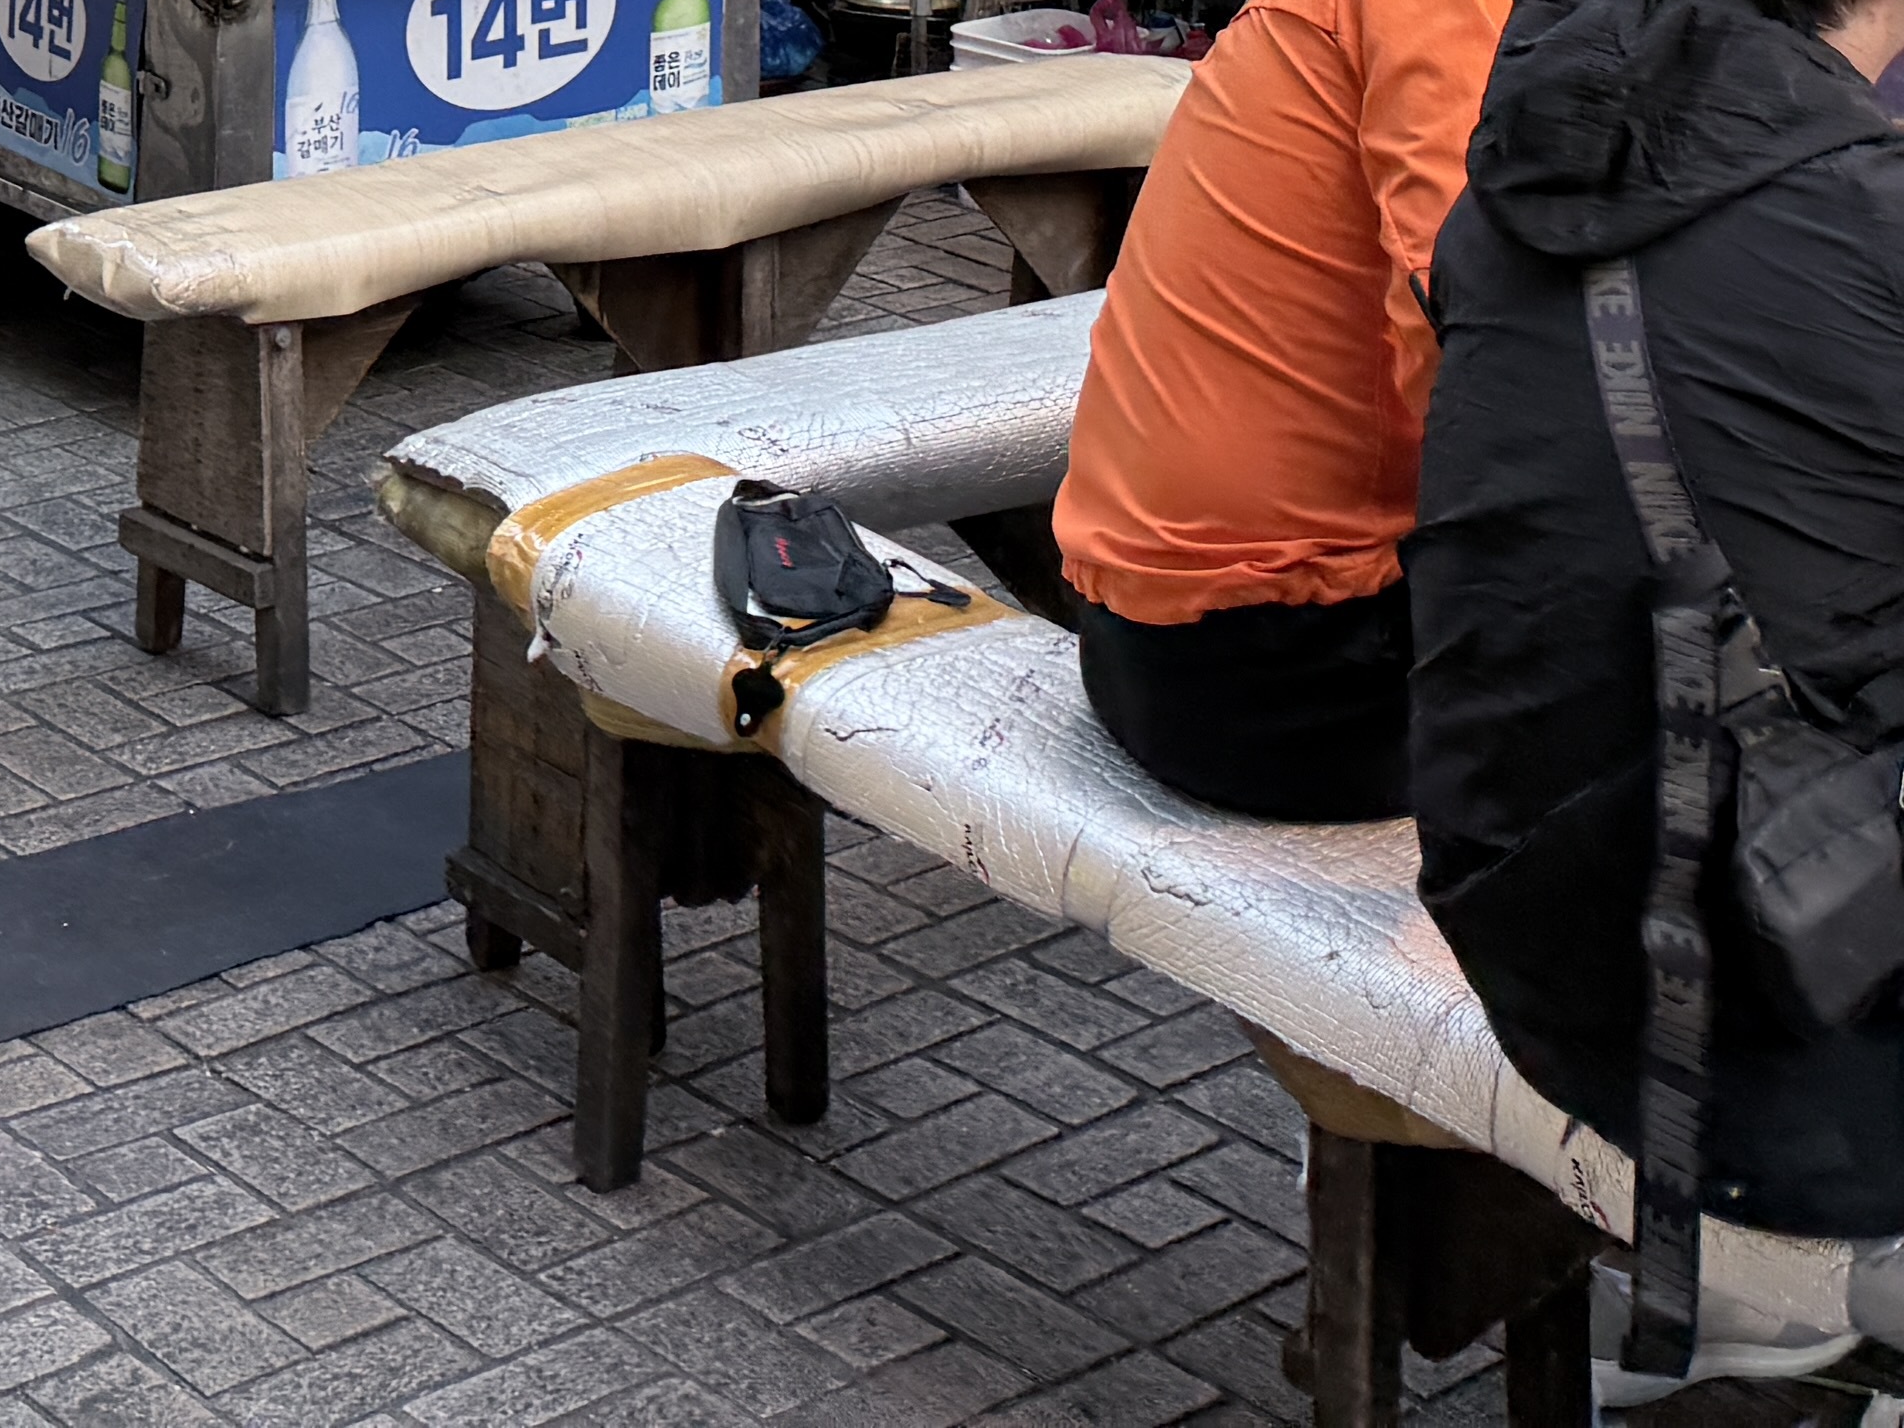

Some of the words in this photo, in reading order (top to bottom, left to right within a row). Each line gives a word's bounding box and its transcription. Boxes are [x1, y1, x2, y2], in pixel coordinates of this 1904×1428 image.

[652, 50, 681, 73] 좋은
[652, 69, 681, 92] 데이
[312, 112, 342, 135] 부산
[296, 133, 346, 161] 갈매기
